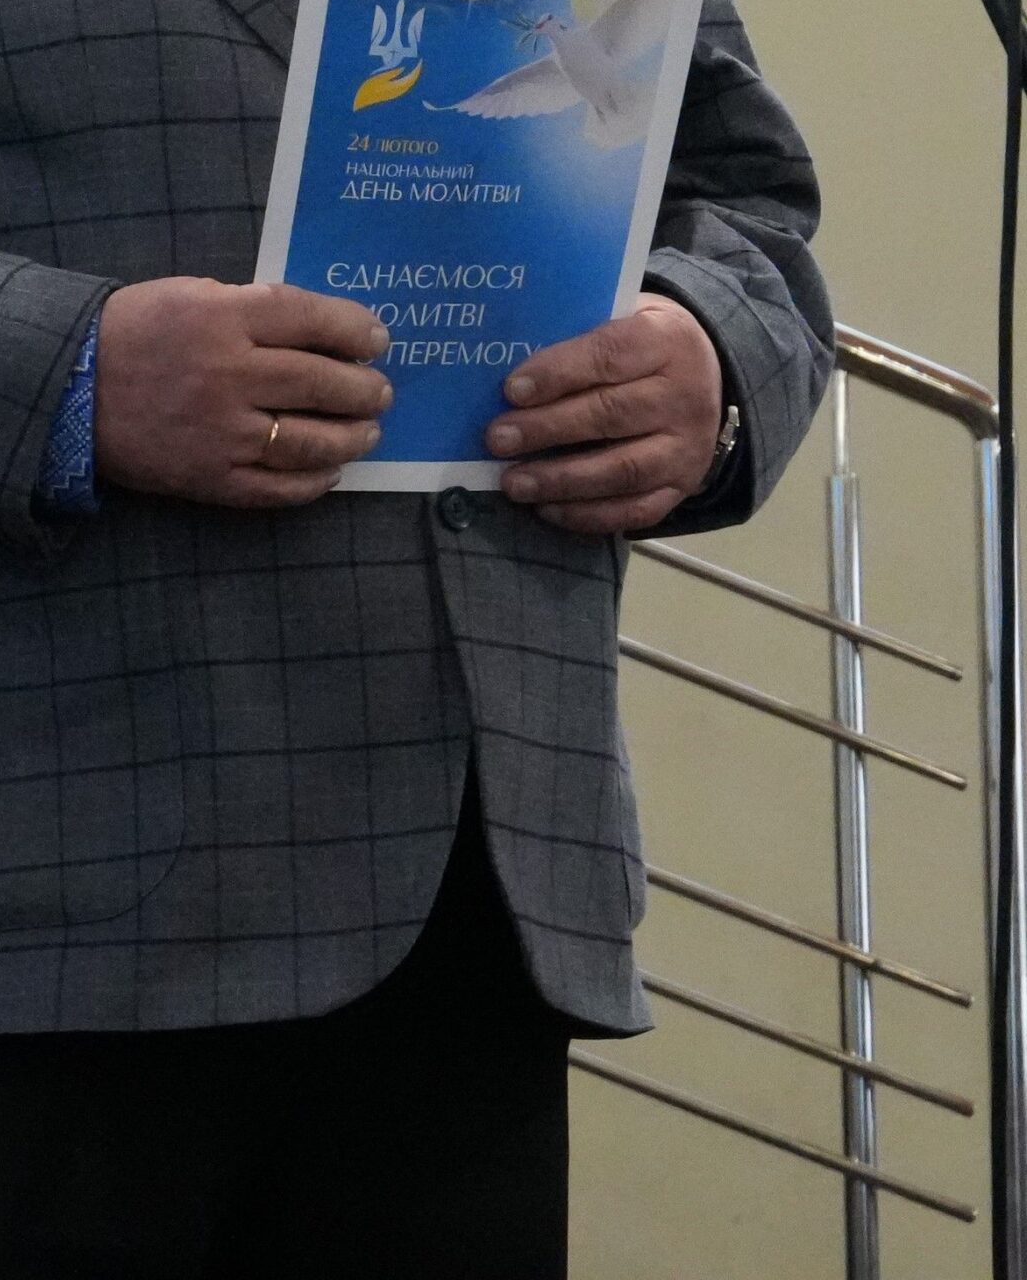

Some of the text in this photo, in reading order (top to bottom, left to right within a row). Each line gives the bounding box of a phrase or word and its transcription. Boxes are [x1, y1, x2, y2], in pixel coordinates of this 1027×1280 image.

[347, 133, 370, 151] 24
[345, 161, 475, 180] НАЦІОНАЛЬНИЙ
[339, 180, 522, 204] ДЕНЬ МОЛИТВИ
[326, 262, 525, 291] ЄДНАЄМОСЯ
[370, 302, 485, 328] ОЛИТВІ
